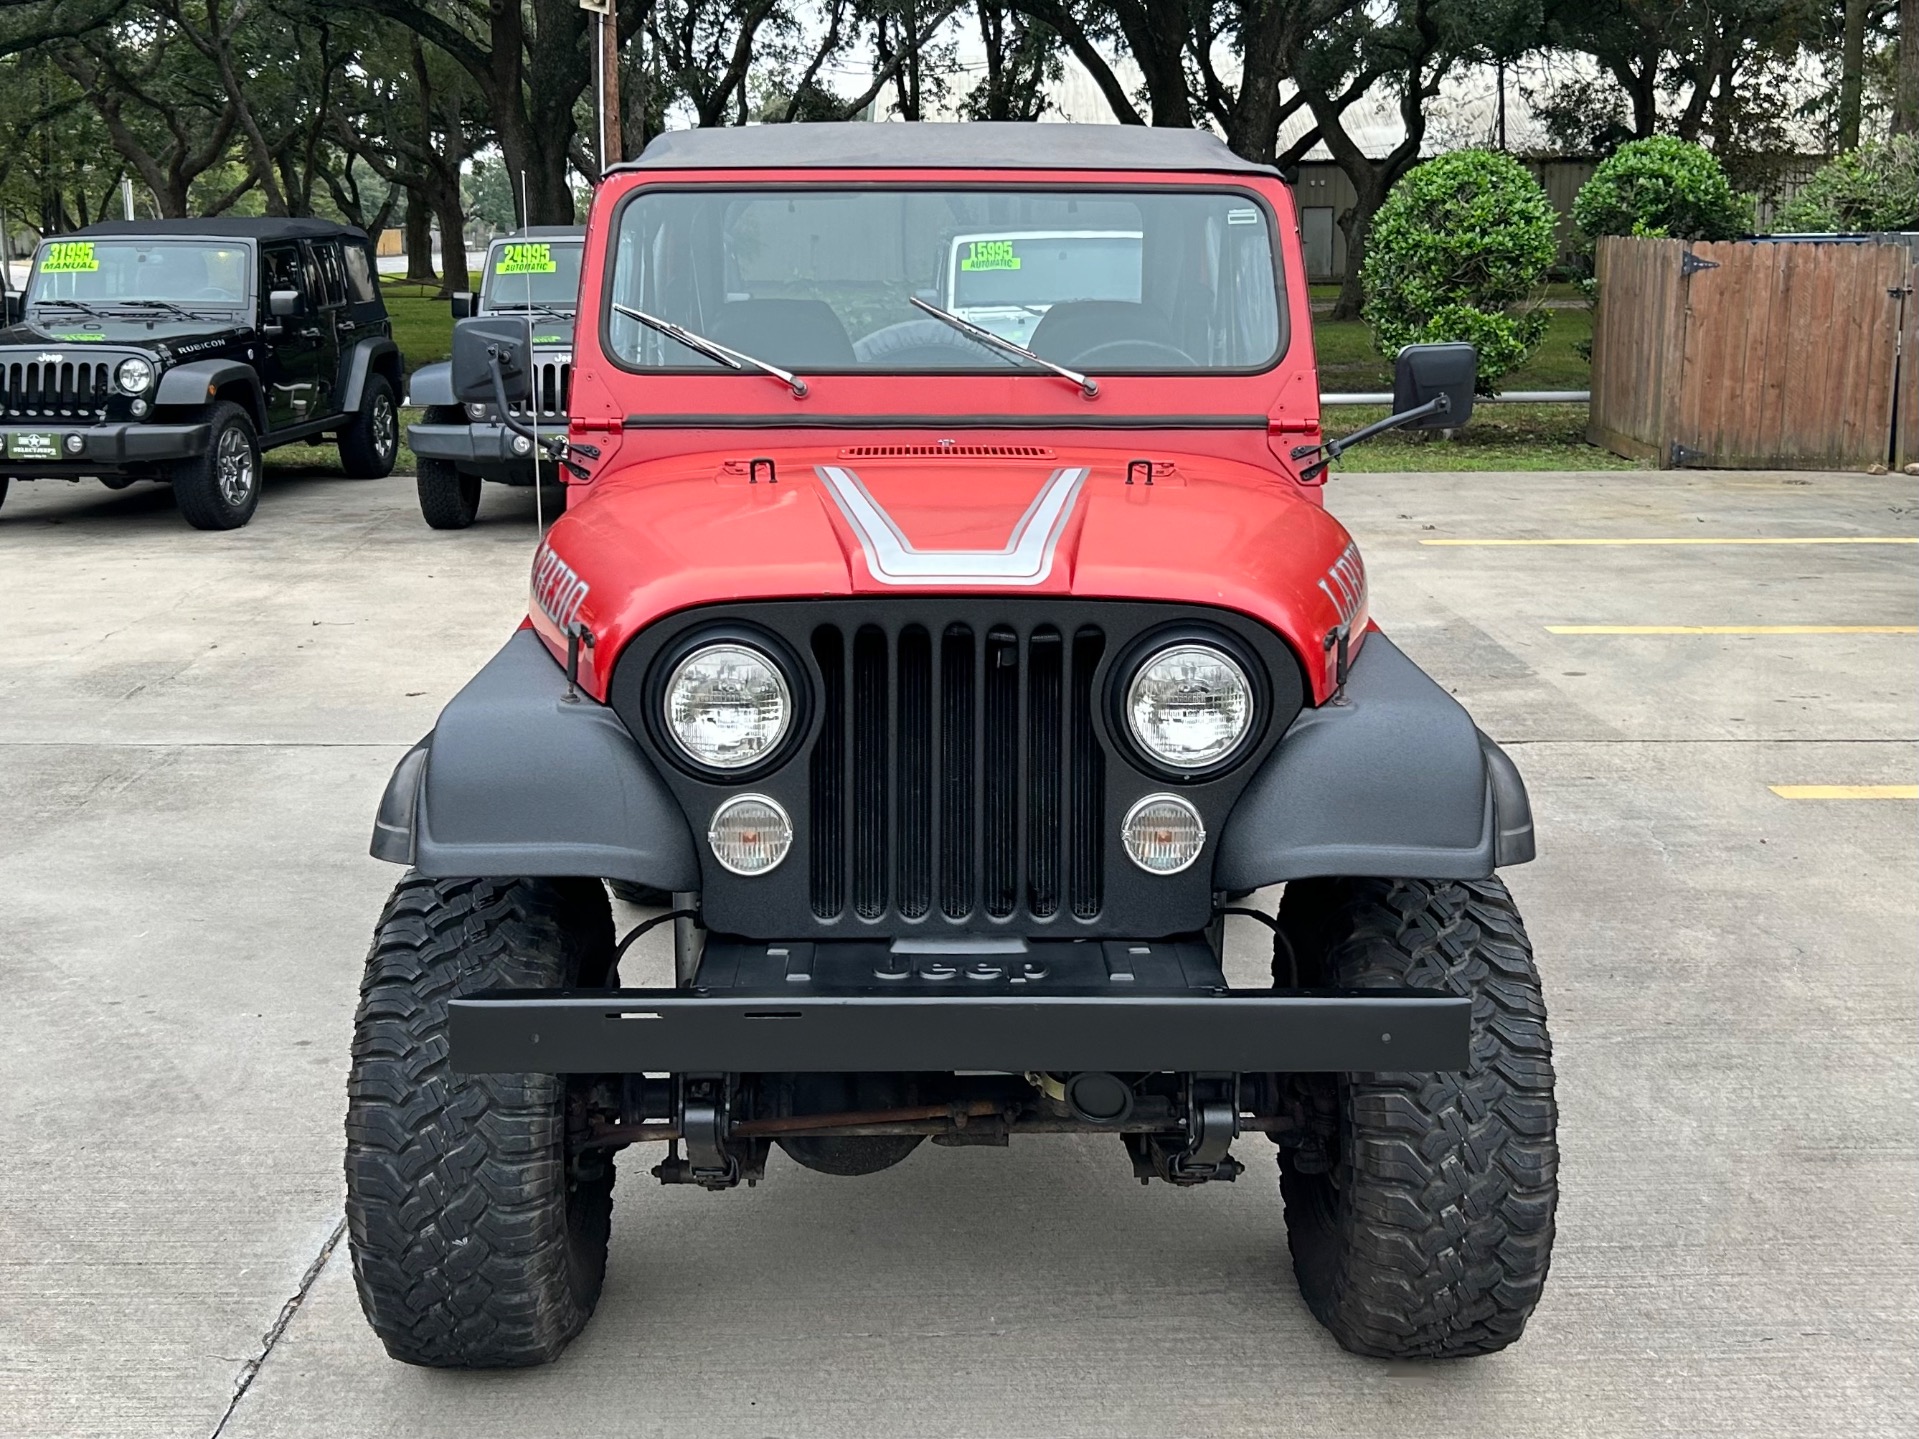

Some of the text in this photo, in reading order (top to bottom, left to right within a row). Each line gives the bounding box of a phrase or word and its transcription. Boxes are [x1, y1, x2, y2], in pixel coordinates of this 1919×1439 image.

[49, 242, 94, 261] 31995
[504, 244, 550, 262] 24995
[969, 241, 1013, 259] 15995
[44, 262, 95, 270] MANUAL
[504, 262, 549, 272] AUTOMATIC
[969, 259, 1013, 269] AUTOMATIC
[178, 338, 226, 354] RUBICON
[38, 352, 63, 363] Jeep
[554, 352, 572, 362] Jee
[873, 954, 1049, 983] Jeep
